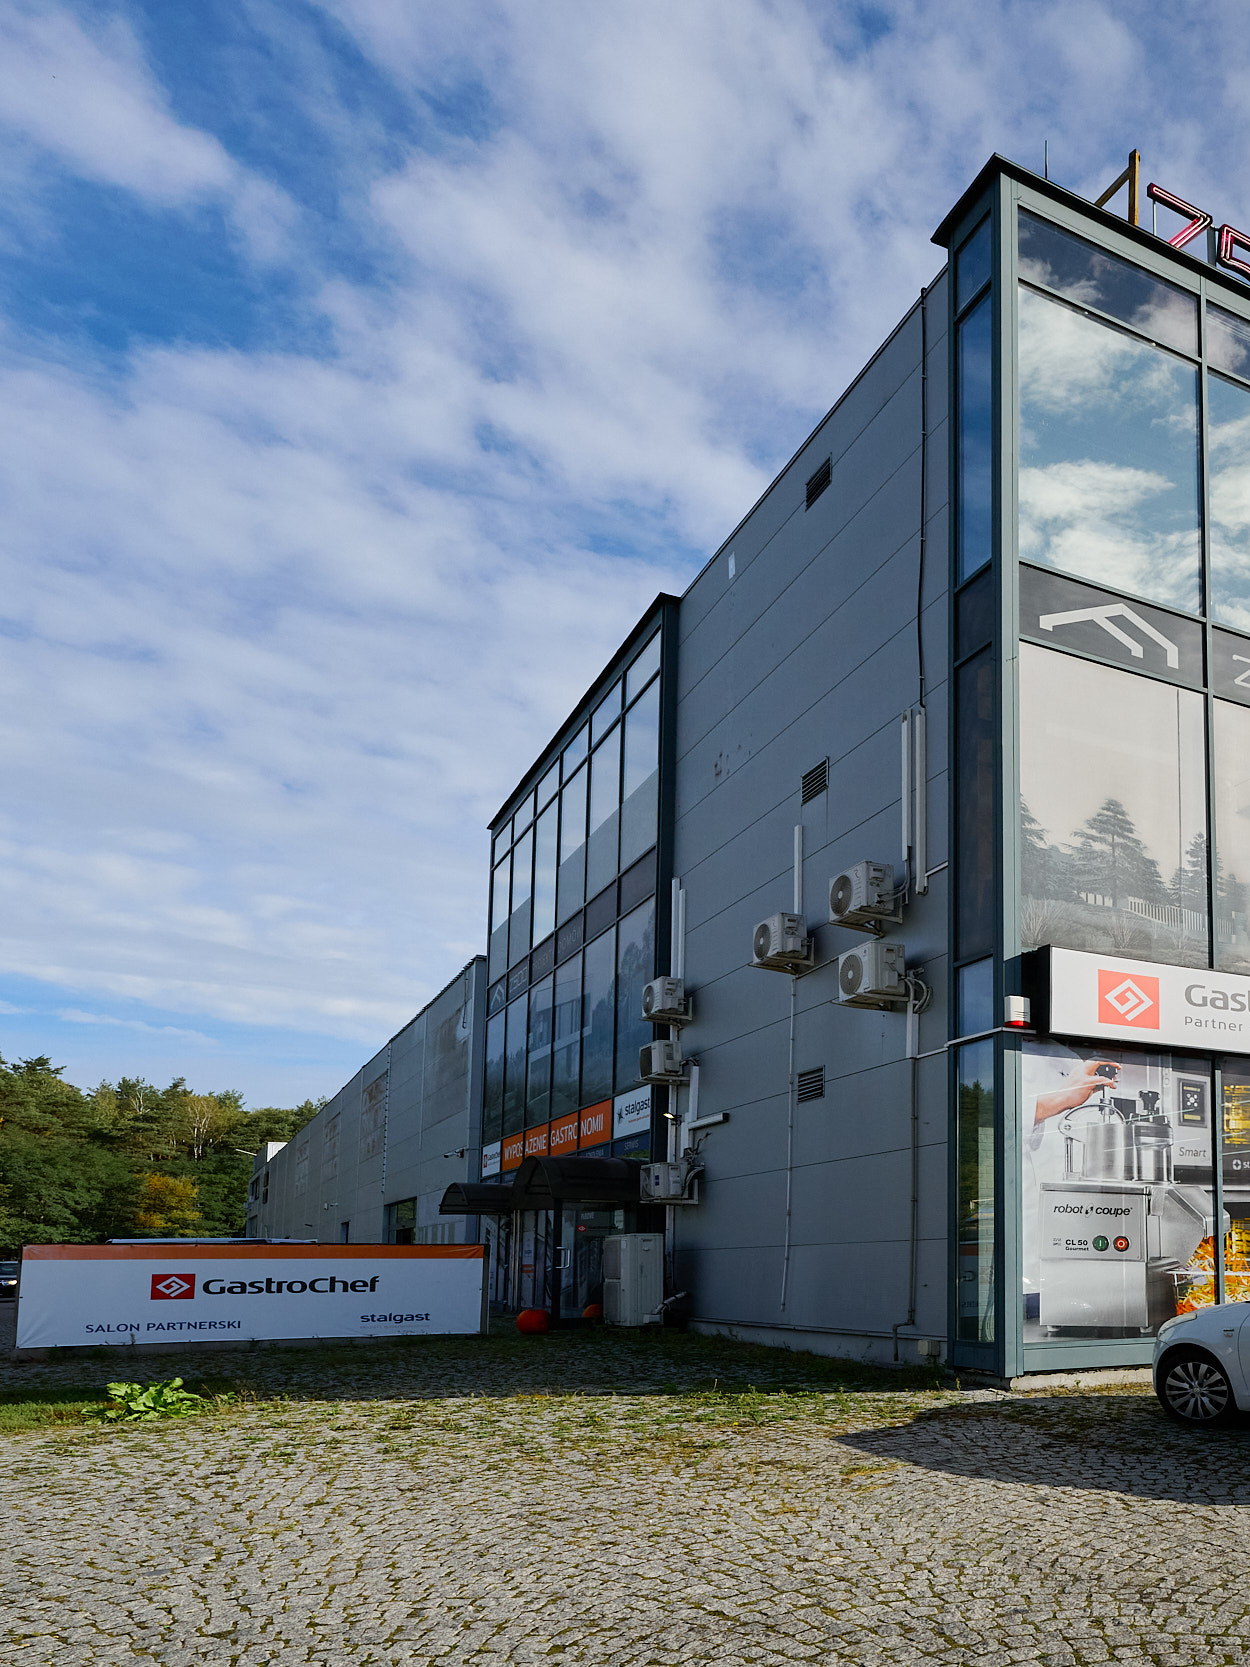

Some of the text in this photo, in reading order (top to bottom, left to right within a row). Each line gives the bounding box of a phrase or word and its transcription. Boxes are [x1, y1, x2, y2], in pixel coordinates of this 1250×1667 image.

[1185, 1016, 1243, 1032] Partner
[624, 1097, 650, 1116] stalgast
[504, 1134, 547, 1161] WYPOSAŻENIE
[1178, 1147, 1207, 1158] Smart
[1053, 1204, 1132, 1218] robot coupe
[202, 1275, 380, 1296] GastroChef
[360, 1312, 430, 1324] stalgast
[85, 1320, 242, 1334] SALON PARTNERSKI
